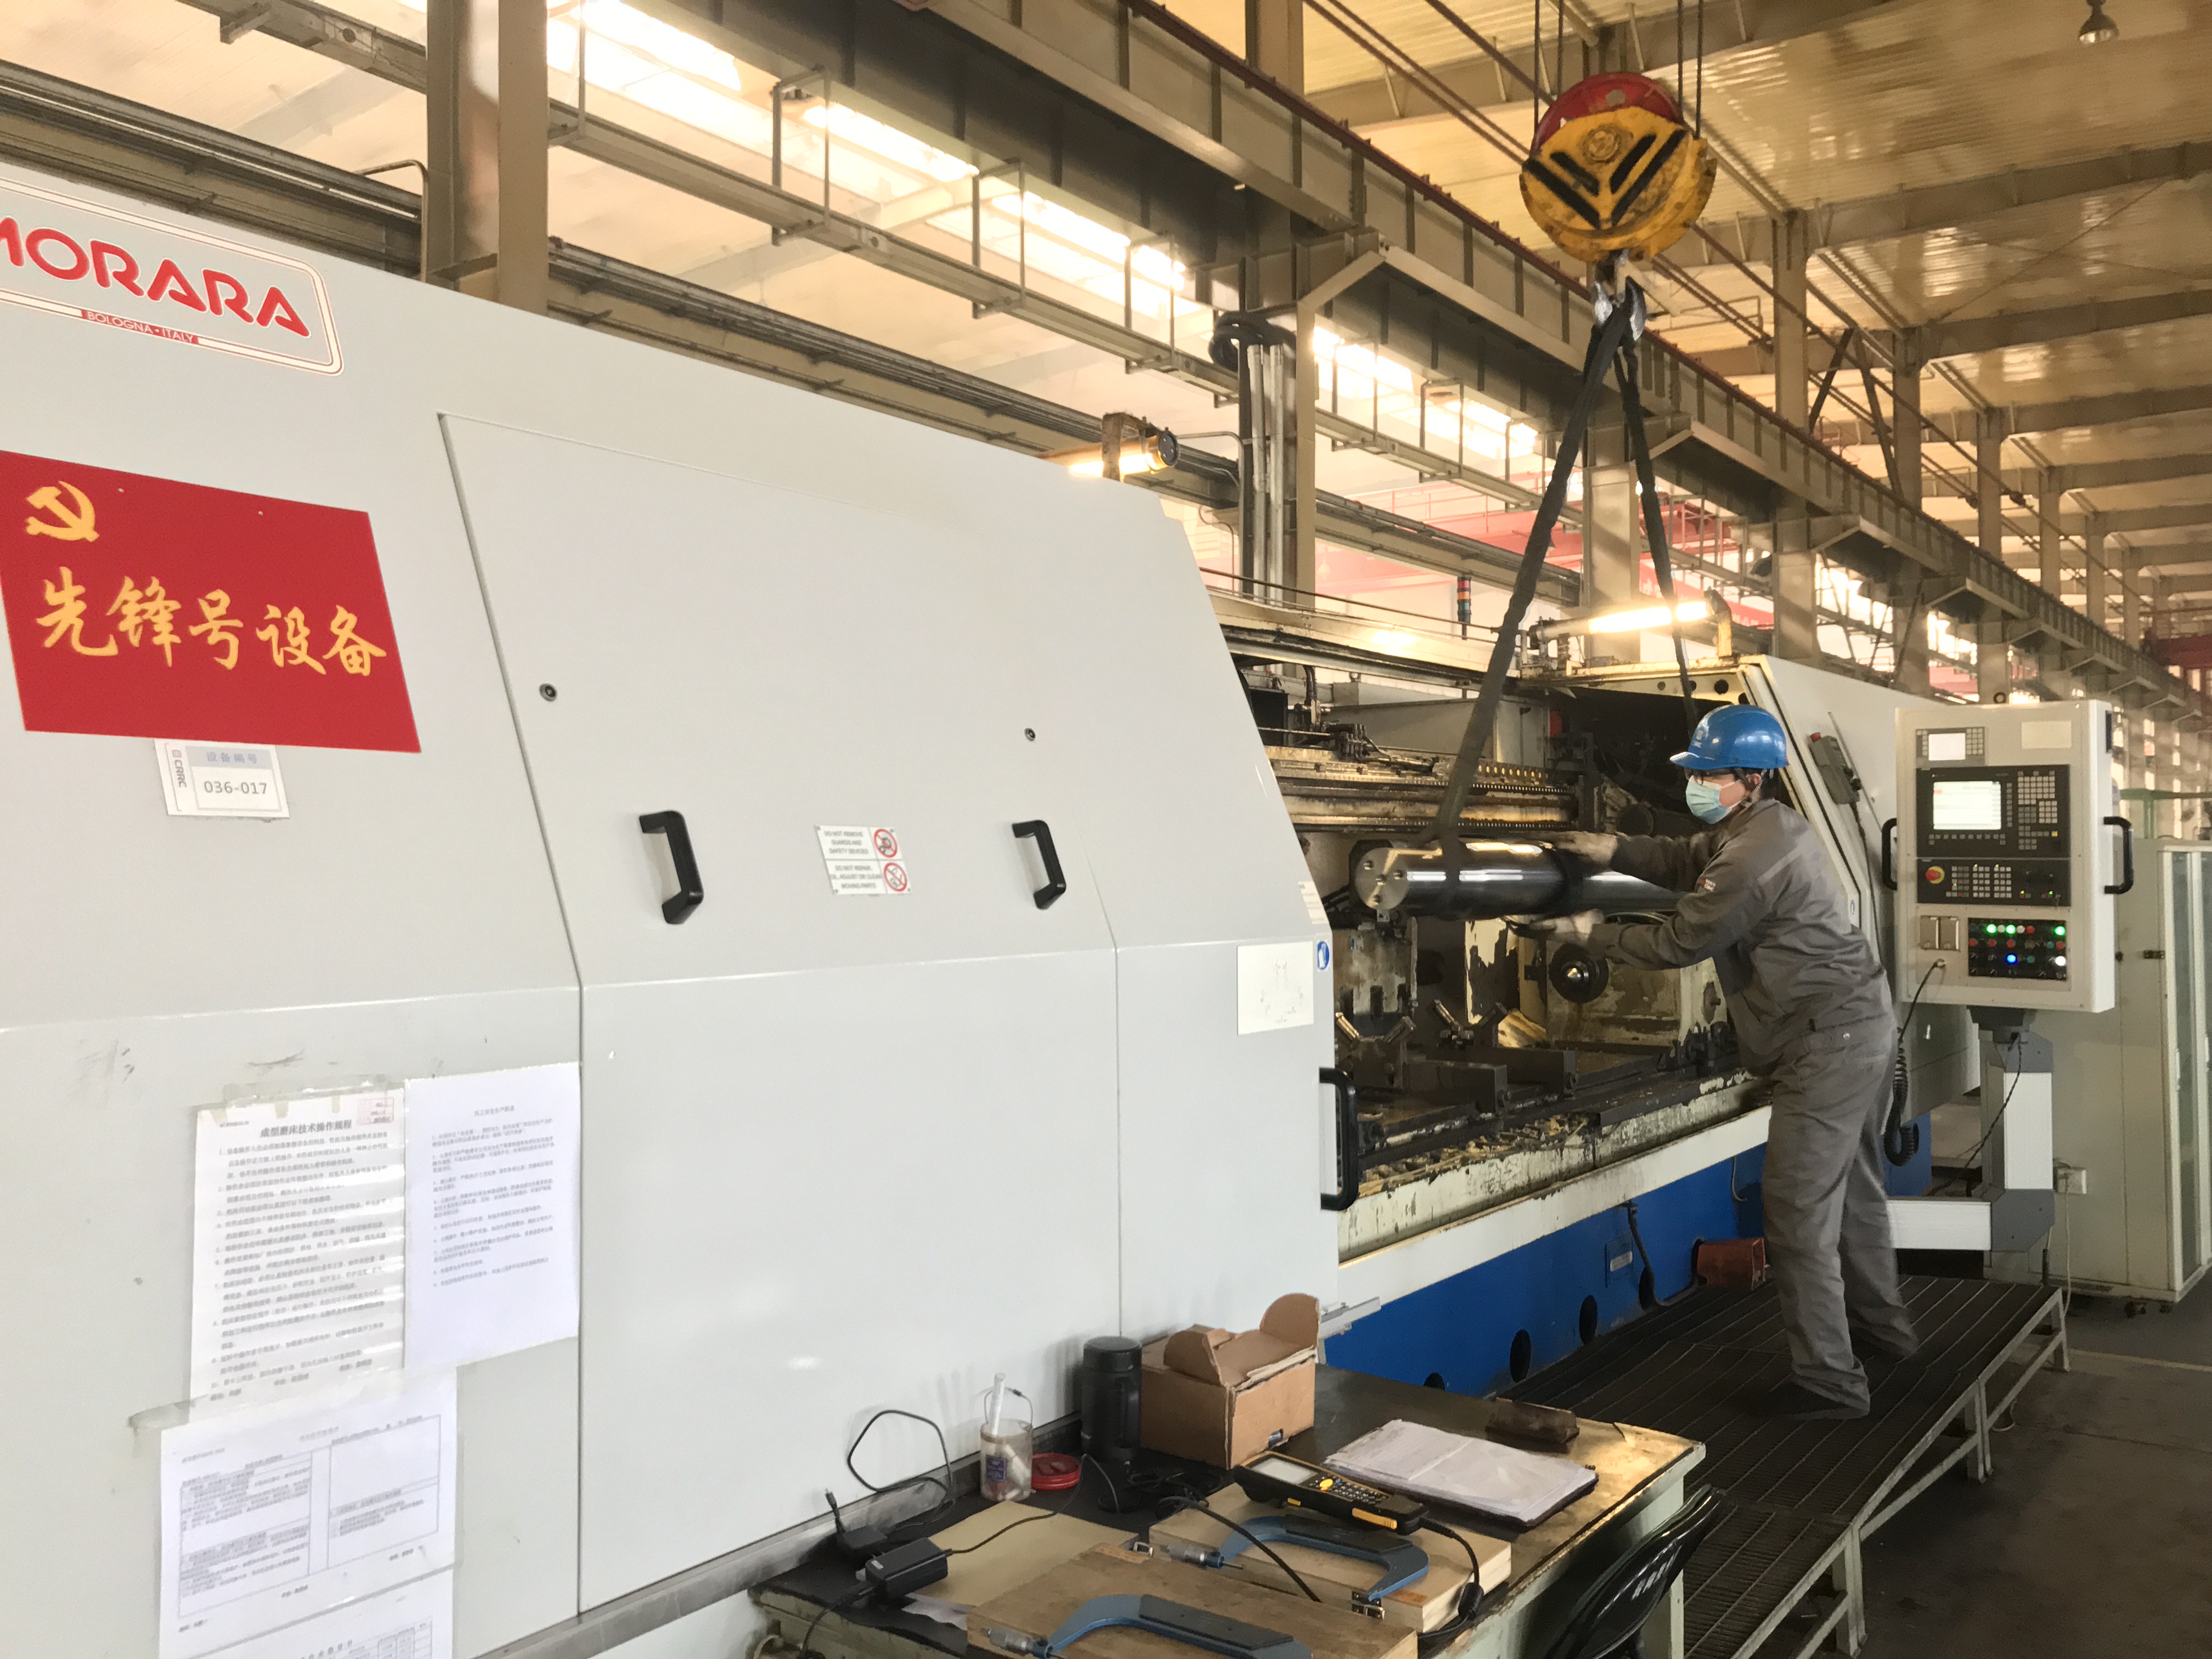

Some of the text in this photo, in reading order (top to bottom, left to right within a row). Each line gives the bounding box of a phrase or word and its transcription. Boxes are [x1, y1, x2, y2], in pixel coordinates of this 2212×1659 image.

[87, 311, 193, 343] BOLOGNA ITALY
[36, 566, 387, 676] 先锋号设备
[206, 752, 257, 763] 设备编号
[204, 780, 268, 794] 036-017
